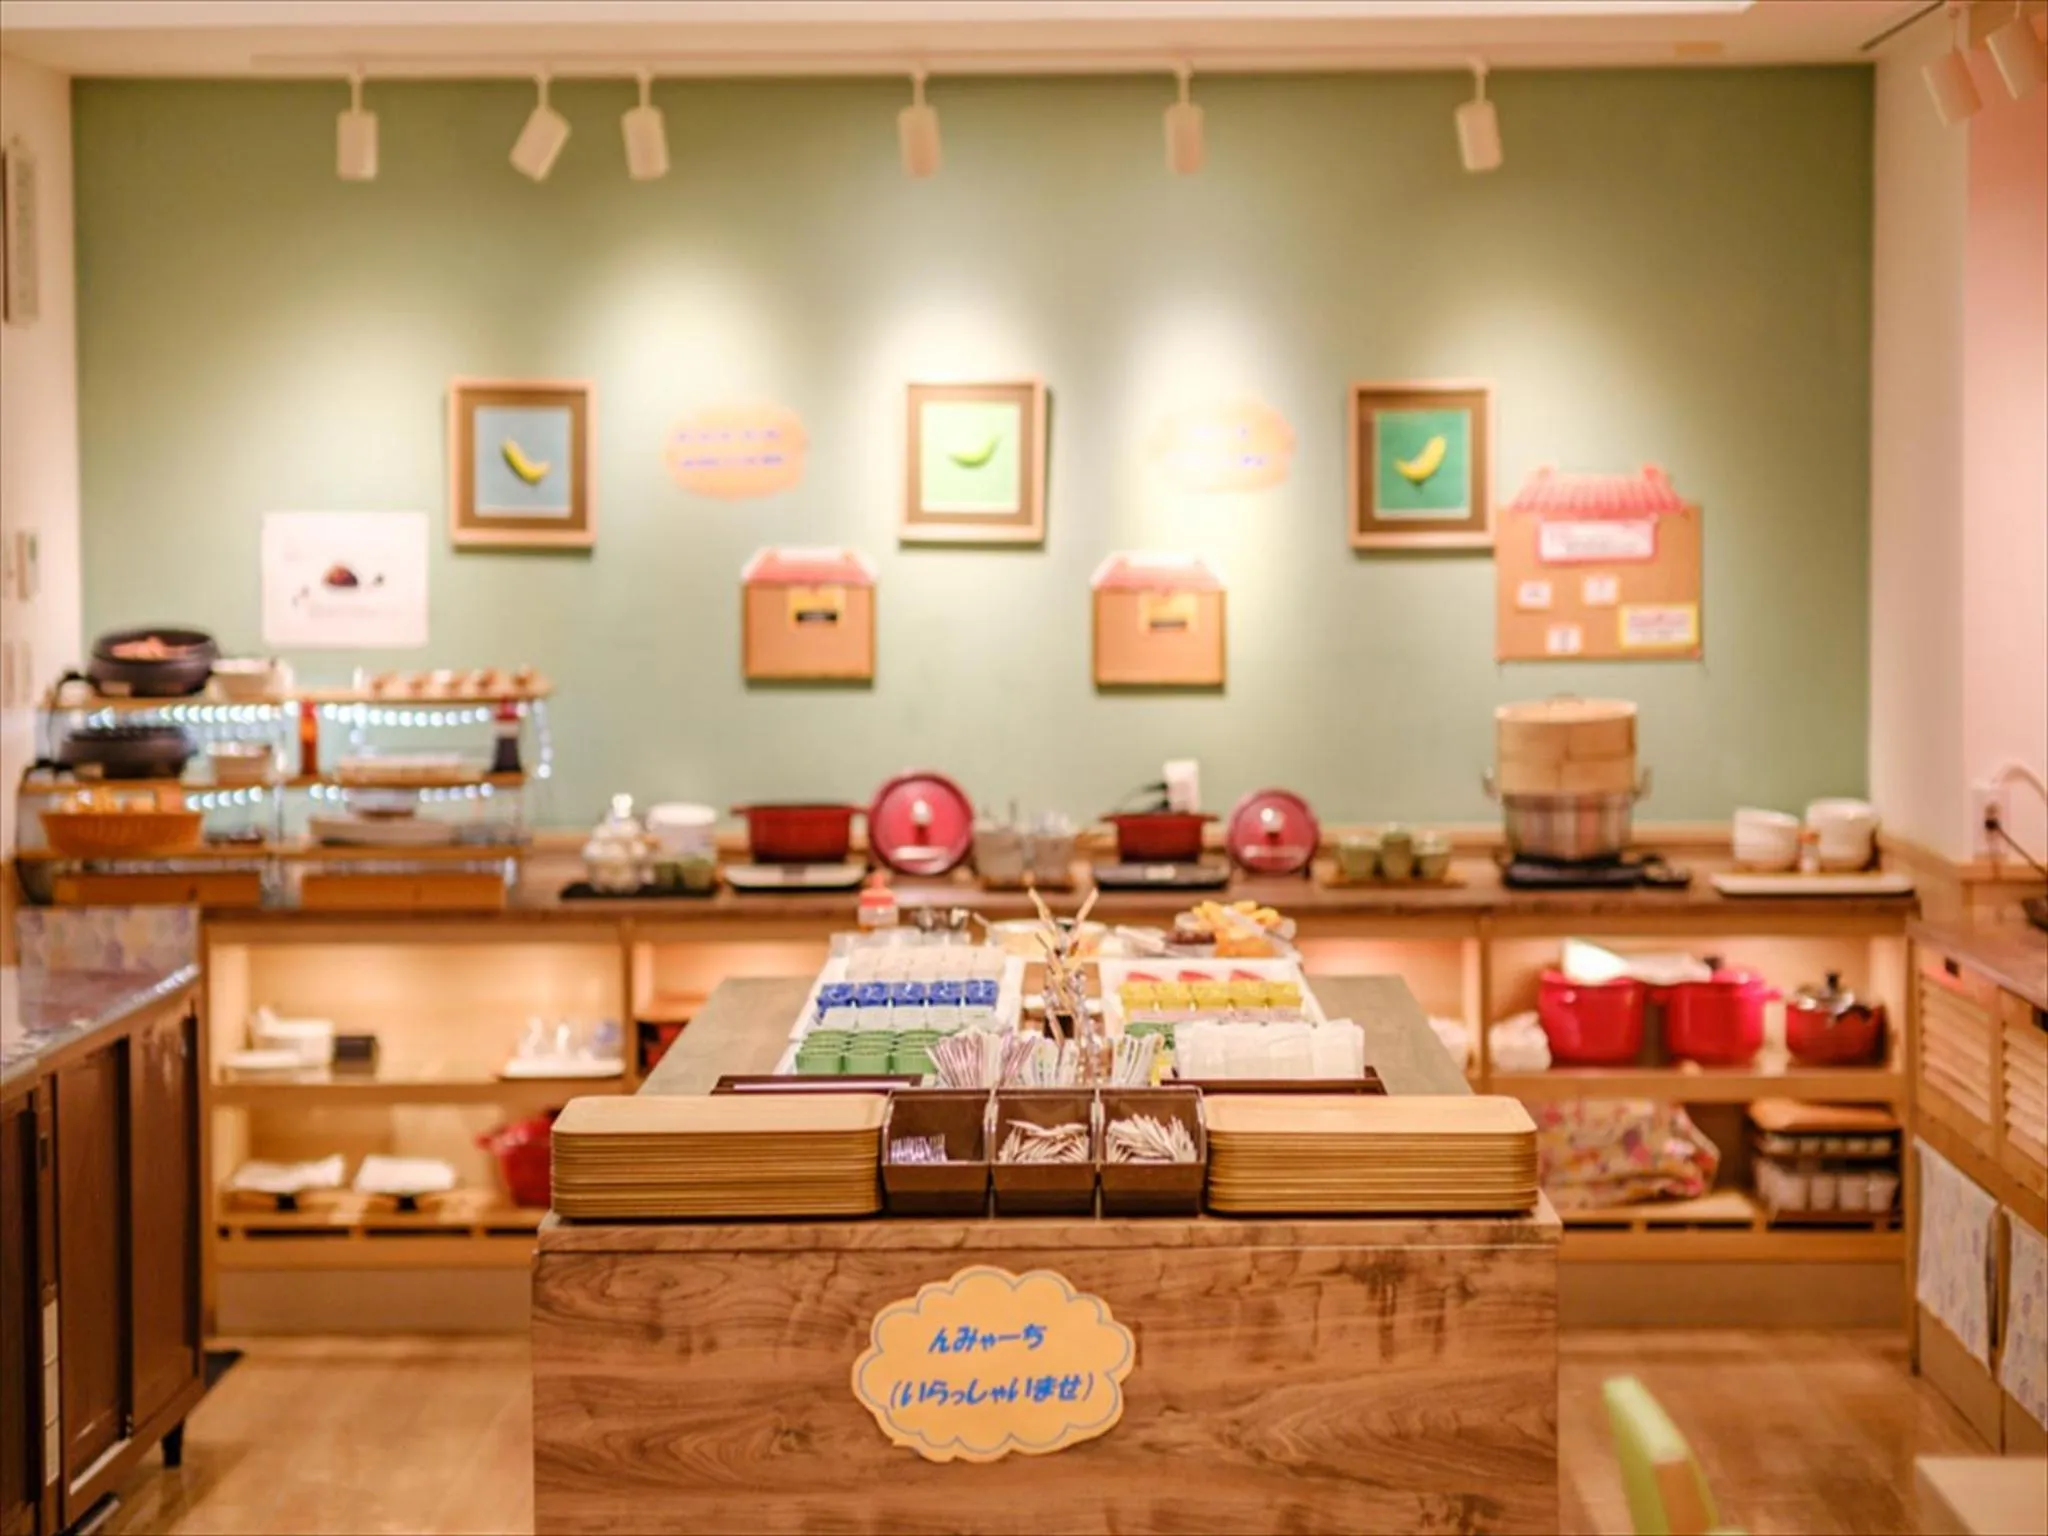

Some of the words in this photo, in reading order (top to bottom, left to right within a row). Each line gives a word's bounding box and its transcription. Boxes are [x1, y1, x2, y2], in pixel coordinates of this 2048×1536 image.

[927, 1322, 1047, 1354] んみゃーち
